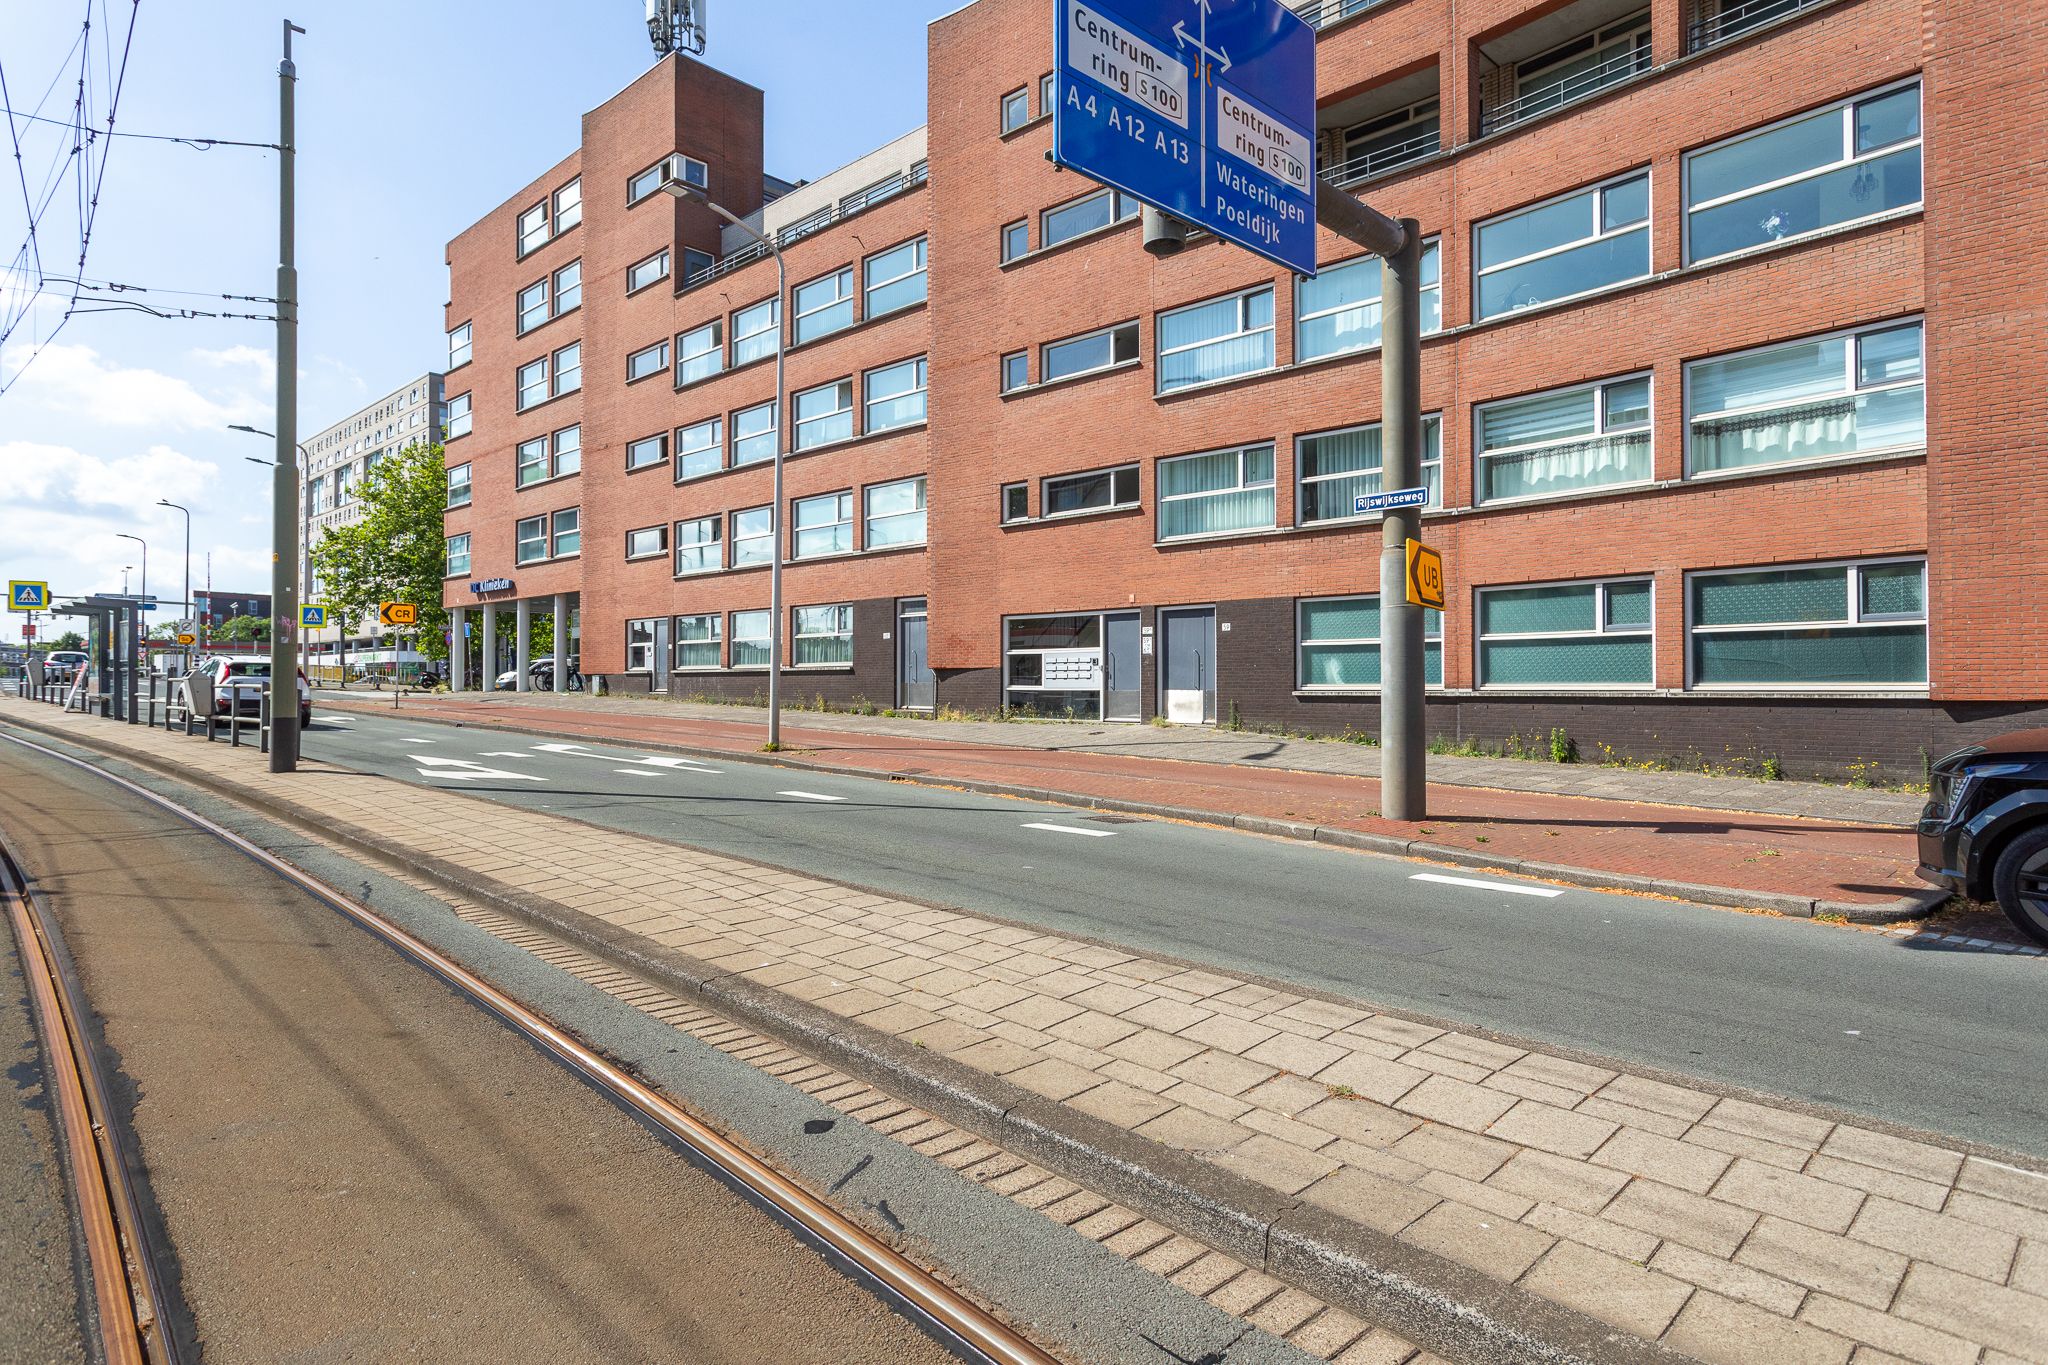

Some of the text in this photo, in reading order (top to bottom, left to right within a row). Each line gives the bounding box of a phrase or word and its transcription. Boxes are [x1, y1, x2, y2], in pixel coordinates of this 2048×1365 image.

[1074, 8, 1162, 73] Centrum-
[1092, 52, 1130, 93] ring
[1067, 84, 1189, 165] A4 A12 A13
[1222, 96, 1291, 148] Centrum-
[1235, 132, 1265, 167] ring
[1216, 160, 1305, 224] Wateringen
[1217, 196, 1281, 245] Poeldijk
[1357, 492, 1424, 510] Rijswijkseweg
[1423, 564, 1438, 589] UB
[395, 609, 411, 618] CR
